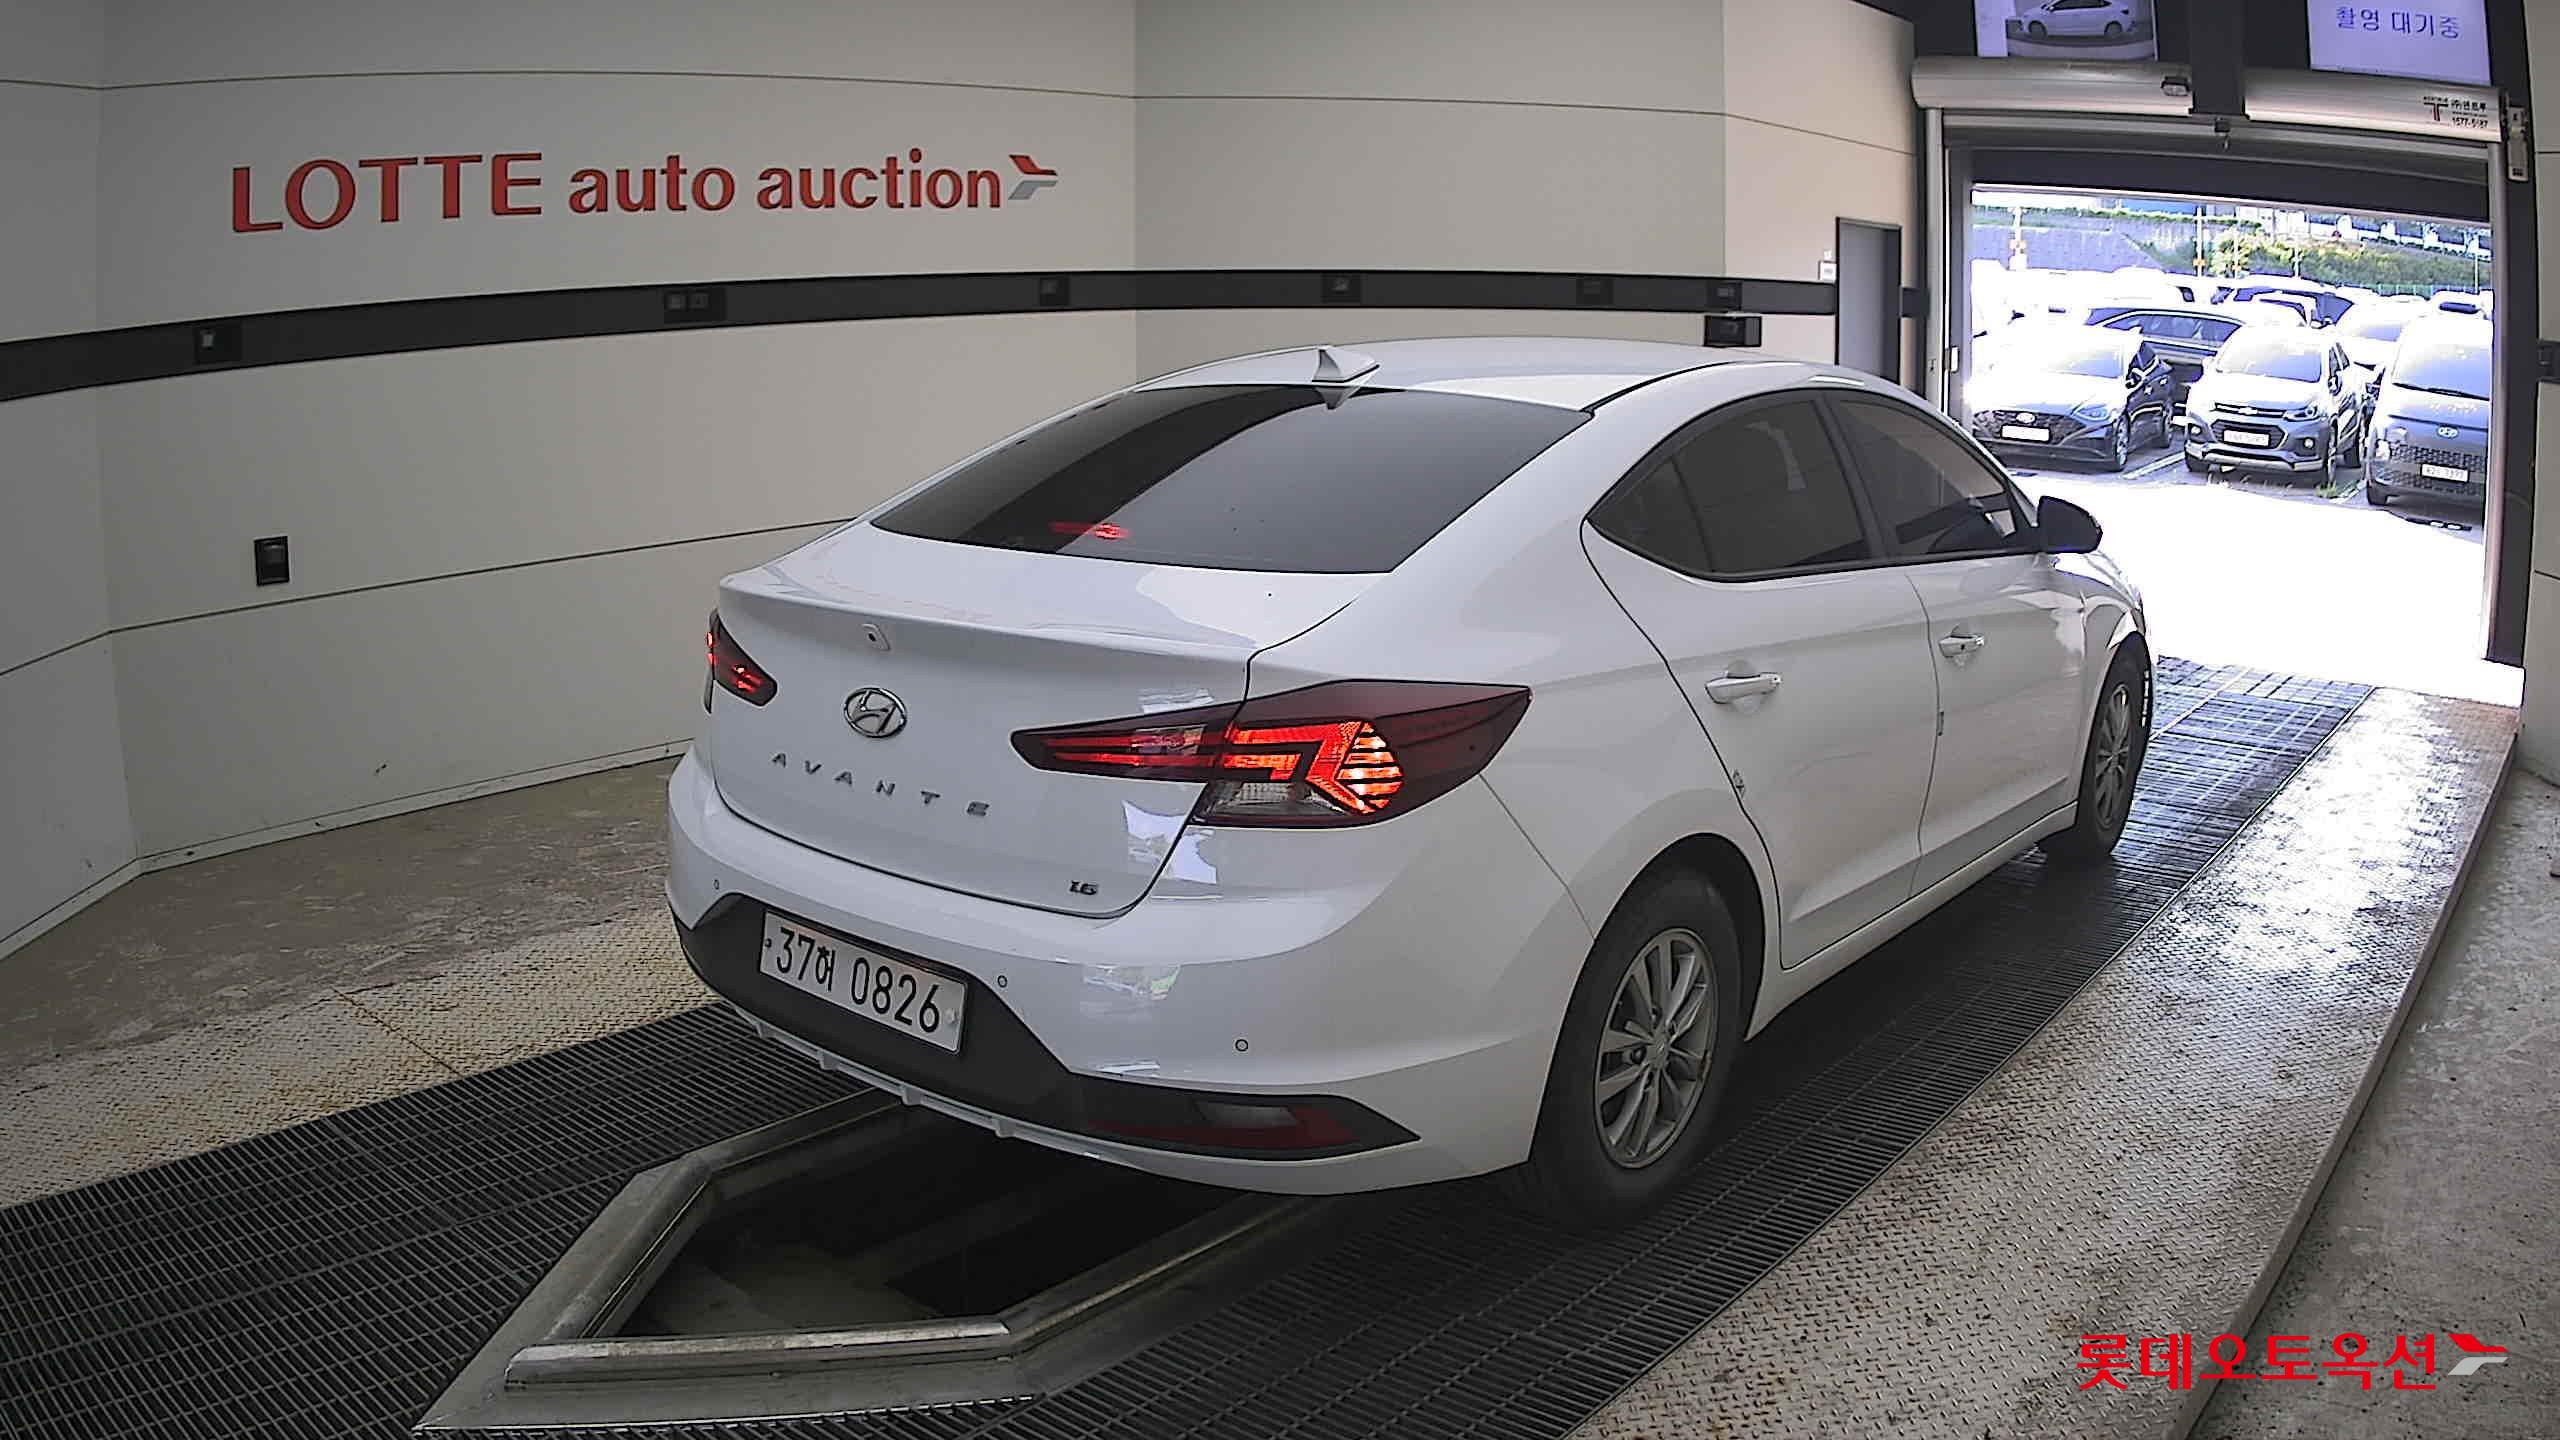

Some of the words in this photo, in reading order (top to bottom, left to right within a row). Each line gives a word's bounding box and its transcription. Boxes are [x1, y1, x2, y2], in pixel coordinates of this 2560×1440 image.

[2337, 6, 2380, 31] 촬영
[2391, 11, 2460, 39] 대기중
[232, 152, 543, 233] LOTTE
[568, 154, 736, 214] auto
[757, 147, 1002, 210] auction
[771, 752, 991, 818] AVANTE
[776, 926, 836, 992] 37허
[850, 957, 940, 1033] 0826
